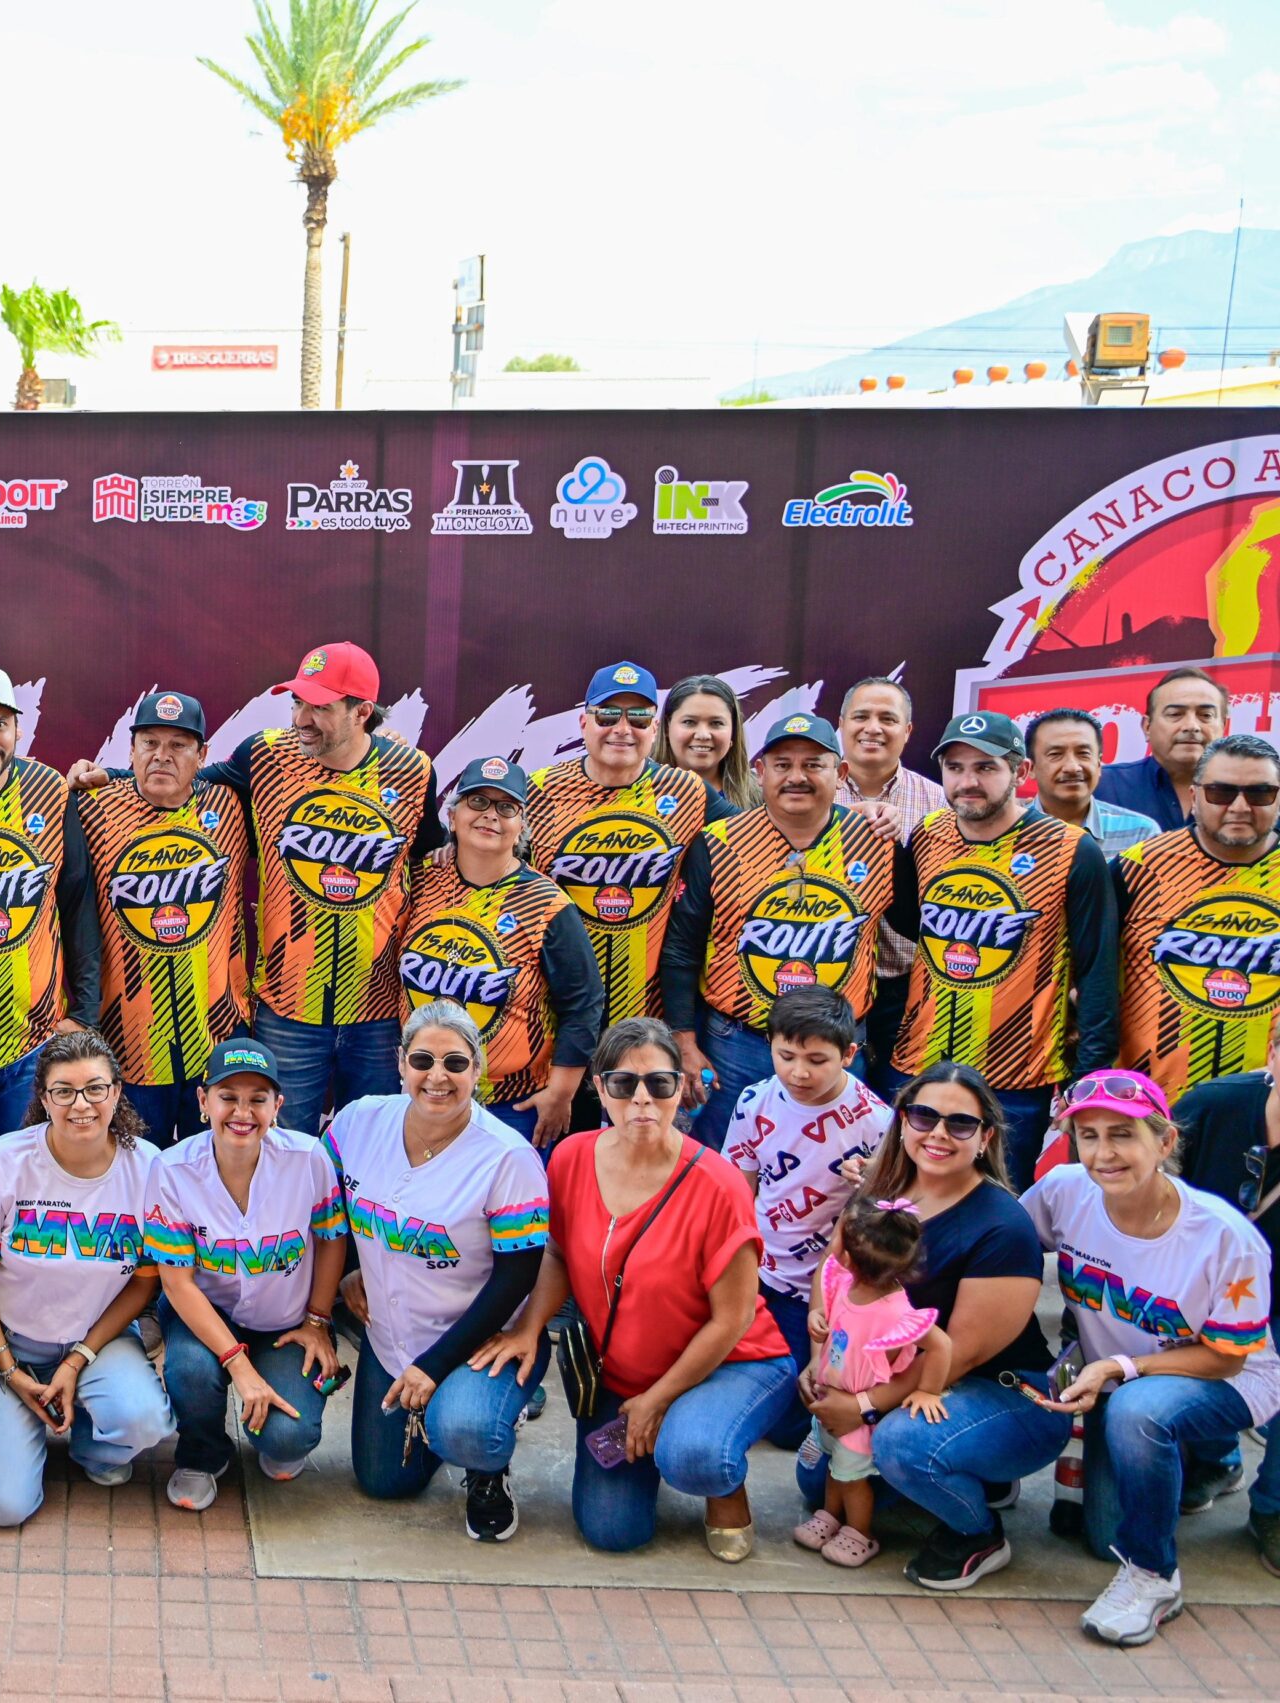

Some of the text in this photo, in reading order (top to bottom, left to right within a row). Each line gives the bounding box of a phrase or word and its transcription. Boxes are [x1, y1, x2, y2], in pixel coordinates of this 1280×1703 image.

[143, 477, 200, 488] TORREÓN
[143, 505, 203, 519] PUEDE
[290, 485, 412, 518] PARRAS
[455, 508, 512, 516] PRENDAMOS
[784, 500, 913, 526] Electrolit
[321, 514, 410, 532] es todo tuyo.
[435, 517, 528, 531] MONCLOVA
[555, 508, 624, 523] nuve
[656, 522, 745, 531] HI-TECH PRINTING
[1034, 456, 1236, 587] CANACO
[303, 802, 382, 832] 15 AÑOS
[277, 825, 408, 873] ROUTE
[574, 828, 657, 851] 15 AÑOS
[127, 843, 203, 871] 15 AÑOS
[550, 844, 684, 888] ROUTE
[109, 855, 230, 908] ROUTE
[321, 876, 359, 886] COAHUILA
[596, 898, 632, 907] COAHUILA
[763, 892, 842, 918] 15 AÑOS
[931, 883, 1005, 907] 15 AÑOS
[152, 916, 189, 926] COAHUILA
[920, 902, 1042, 948] ROUTE
[1186, 910, 1280, 933] 15 AÑOS
[420, 932, 440, 951] 15
[738, 912, 869, 965] ROUTE
[399, 951, 519, 1004] ROUTE
[344, 1174, 360, 1191] DE
[425, 1259, 461, 1270] SOY
